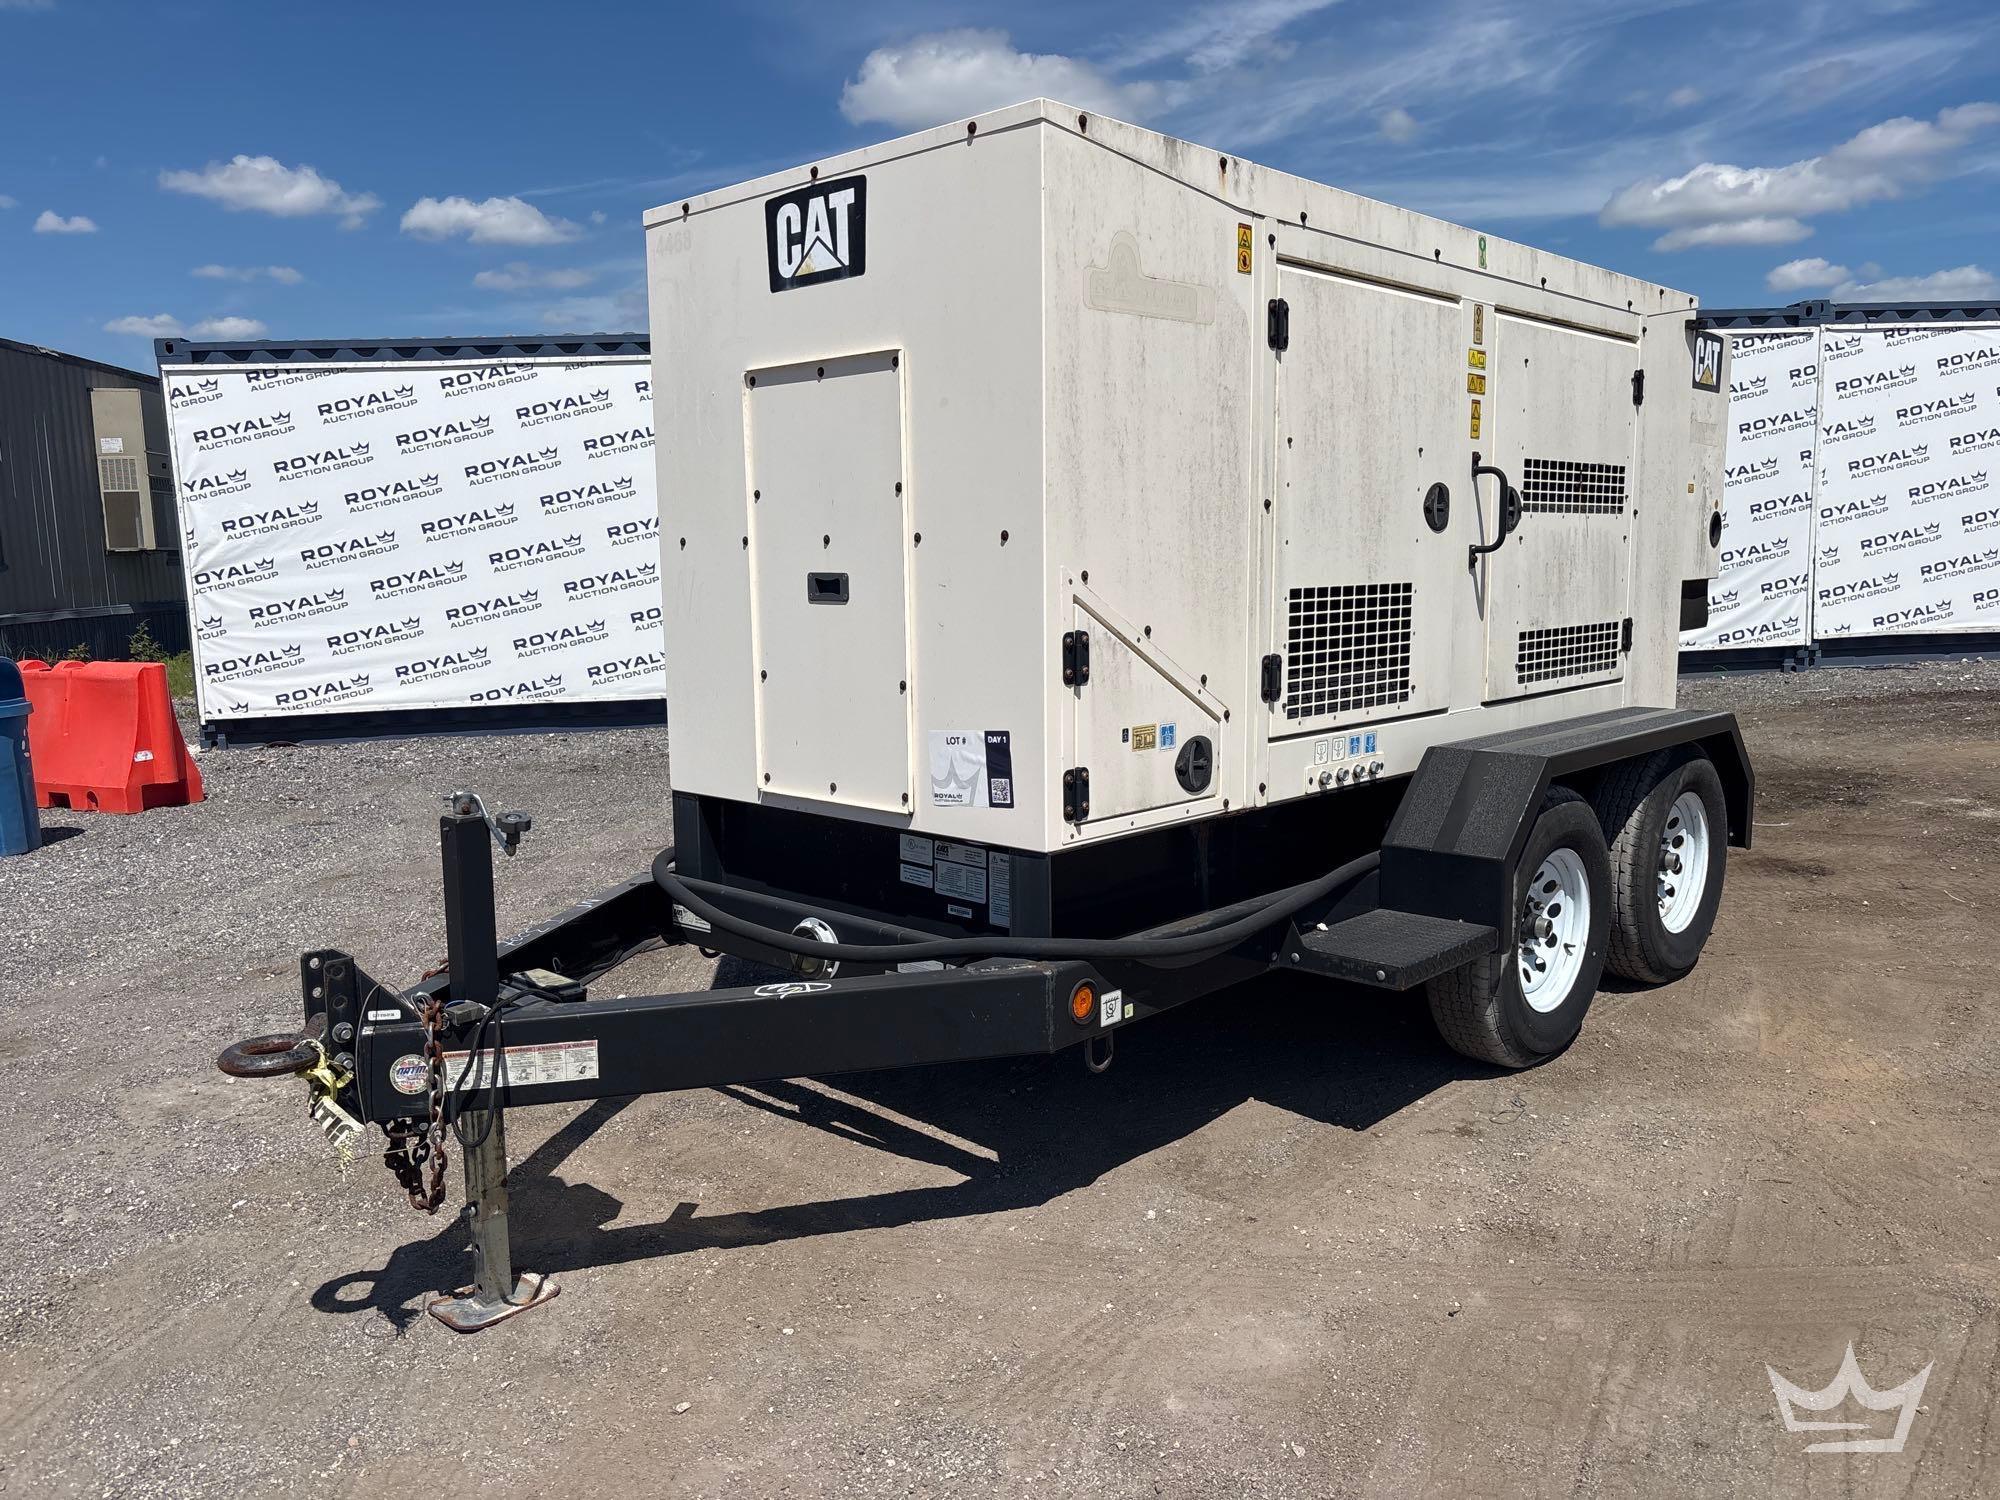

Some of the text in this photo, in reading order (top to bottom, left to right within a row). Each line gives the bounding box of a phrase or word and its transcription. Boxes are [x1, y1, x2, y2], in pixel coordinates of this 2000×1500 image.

[777, 187, 855, 279] CAT
[1886, 334, 1928, 347] AUCTION
[1694, 336, 1721, 386] CAT
[1829, 348, 1863, 360] GROUP
[1937, 348, 1999, 369] ROYAL
[440, 364, 516, 390] ROYAL
[1836, 370, 1900, 392] ROYAL
[1940, 363, 1982, 376] AUCTION
[251, 376, 304, 392] AUCTION
[445, 372, 538, 398] AUCTION GROUP
[1733, 389, 1768, 402] GROUP
[1838, 378, 1917, 400] AUCTION GROUP
[181, 393, 223, 407] GROUP
[318, 391, 395, 416] ROYAL
[323, 399, 417, 424] AUCTION GROUP
[516, 395, 591, 419] ROYAL
[1896, 398, 1959, 419] ROYAL
[521, 403, 613, 428] AUCTION GROUP
[1738, 411, 1804, 434] ROYAL
[1899, 405, 1976, 427] AUCTION GROUP
[193, 418, 272, 443] ROYAL
[199, 426, 295, 452] AUCTION GROUP
[396, 422, 472, 446] ROYAL
[401, 429, 494, 455] AUCTION GROUP
[584, 427, 654, 451] ROYAL
[1741, 427, 1785, 442] AUCTION
[1842, 428, 1876, 440] GROUP
[274, 448, 351, 473] ROYAL
[588, 444, 638, 459] AUCTION
[1952, 442, 1994, 455] AUCTION
[279, 456, 374, 482] AUCTION GROUP
[464, 453, 540, 478] ROYAL
[1848, 450, 1912, 472] ROYAL
[1851, 456, 1930, 479] AUCTION GROUP
[470, 461, 561, 486] AUCTION GROUP
[1744, 470, 1780, 483] GROUP
[210, 483, 251, 497] GROUP
[344, 480, 420, 505] ROYAL
[540, 483, 614, 507] ROYAL
[1909, 476, 1971, 498] ROYAL
[1911, 483, 1989, 505] AUCTION GROUP
[350, 488, 442, 514] AUCTION GROUP
[545, 490, 636, 516] AUCTION GROUP
[1750, 492, 1812, 514] ROYAL
[222, 507, 300, 532] ROYAL
[421, 510, 496, 534] ROYAL
[1752, 508, 1796, 522] AUCTION
[1854, 507, 1888, 520] GROUP
[227, 515, 322, 541] AUCTION GROUP
[426, 517, 518, 542] AUCTION GROUP
[1861, 528, 1924, 550] ROYAL
[300, 537, 377, 562] ROYAL
[306, 544, 399, 570] AUCTION GROUP
[489, 540, 563, 564] ROYAL
[1755, 550, 1790, 563] GROUP
[1863, 535, 1942, 558] AUCTION GROUP
[494, 548, 585, 573] AUCTION GROUP
[1920, 554, 1983, 576] ROYAL
[238, 572, 278, 585] GROUP
[370, 567, 445, 592] ROYAL
[376, 574, 467, 600] AUCTION GROUP
[564, 569, 638, 593] ROYAL
[1923, 569, 1965, 583] AUCTION
[569, 576, 659, 602] AUCTION GROUP
[1819, 578, 1882, 600] ROYAL
[1822, 585, 1900, 607] AUCTION GROUP
[249, 595, 326, 620] ROYAL
[255, 602, 348, 628] AUCTION GROUP
[446, 596, 520, 620] ROYAL
[451, 603, 542, 628] AUCTION GROUP
[1873, 605, 1936, 627] ROYAL
[1920, 612, 1953, 624] GROUP
[327, 623, 402, 648] ROYAL
[332, 630, 424, 656] AUCTION GROUP
[513, 626, 587, 650] ROYAL
[1718, 622, 1782, 644] ROYAL
[1765, 628, 1801, 641] GROUP
[518, 633, 608, 658] AUCTION GROUP
[205, 651, 282, 676] ROYAL
[211, 658, 305, 684] AUCTION GROUP
[395, 653, 469, 678] ROYAL
[400, 660, 491, 686] AUCTION GROUP
[587, 654, 660, 678] ROYAL
[592, 670, 641, 686] AUCTION
[276, 680, 351, 705] ROYAL
[334, 688, 373, 701] GROUP
[527, 687, 566, 698] GROUP
[946, 737, 966, 745] LOT #
